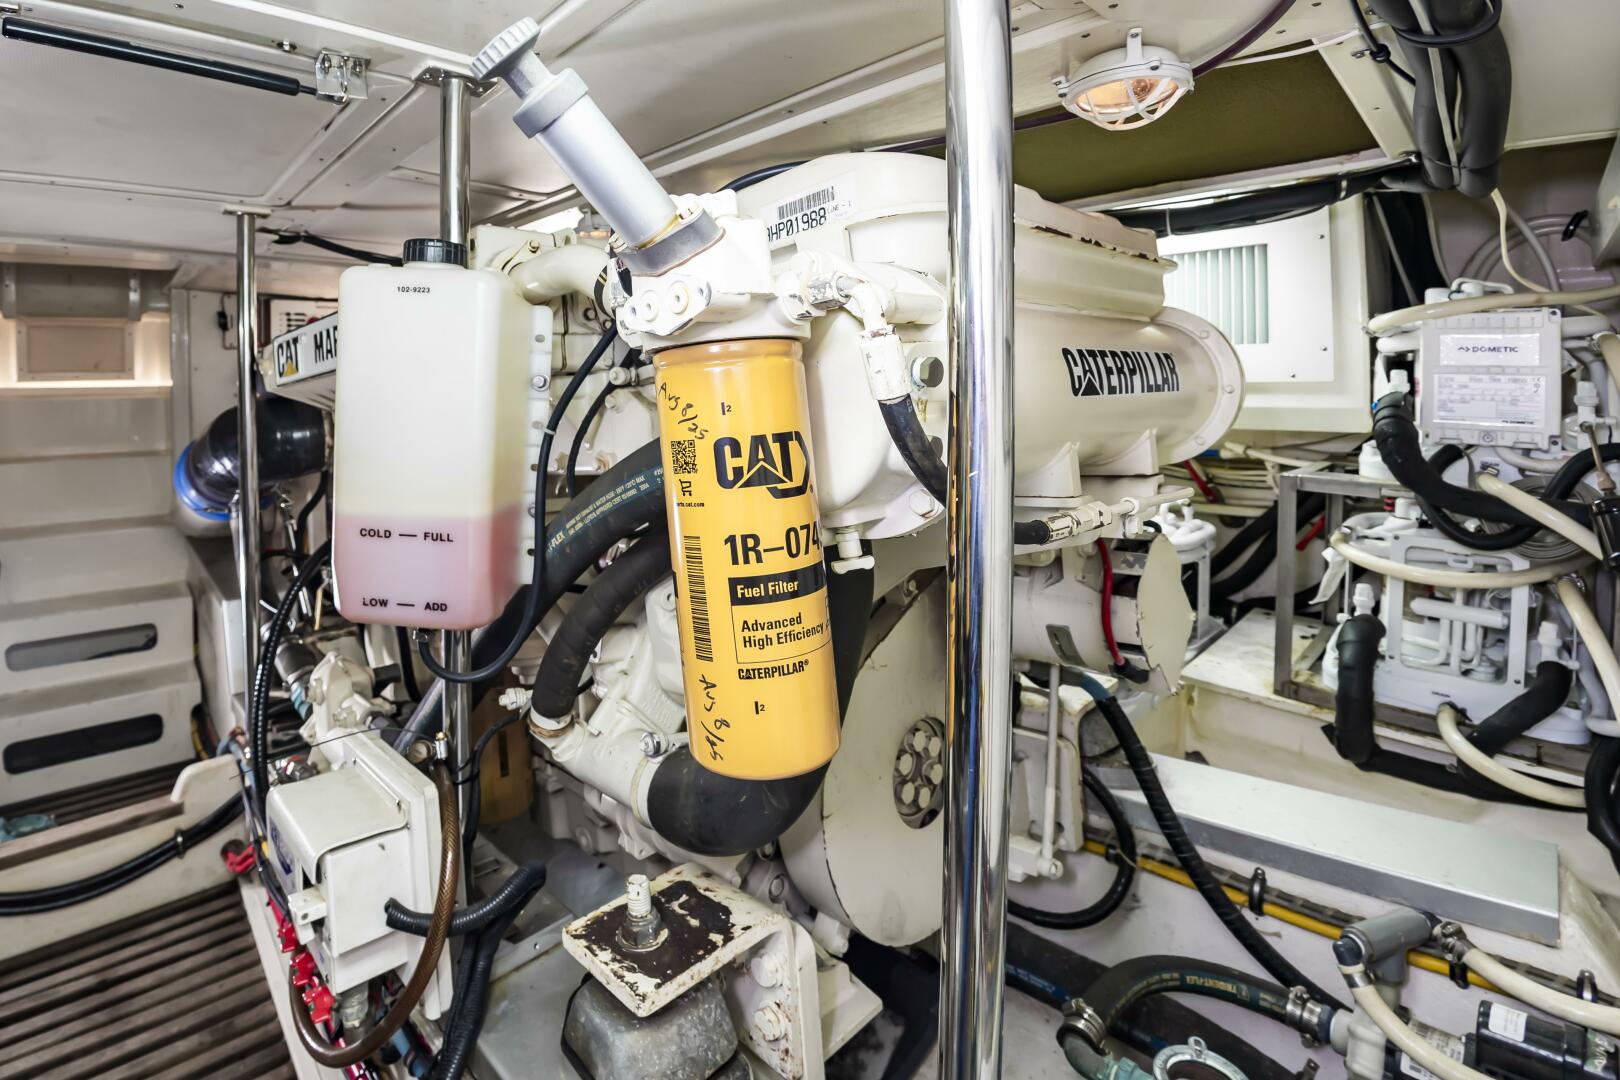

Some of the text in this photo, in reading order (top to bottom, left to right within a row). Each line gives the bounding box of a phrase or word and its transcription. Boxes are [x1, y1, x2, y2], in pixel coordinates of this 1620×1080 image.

[397, 286, 431, 294] 102-9223
[277, 336, 299, 378] CAT
[1061, 347, 1180, 397] CATERPILLAR
[713, 431, 794, 490] CAT
[359, 527, 392, 539] COLD
[423, 531, 454, 543] FULL
[724, 520, 824, 566] 1R-074
[736, 579, 799, 598] Fuel Filter
[362, 597, 389, 608] LOW
[424, 601, 448, 612] ADD
[741, 612, 802, 633] Advanced
[742, 633, 773, 650] High
[776, 622, 824, 645] Efficiency
